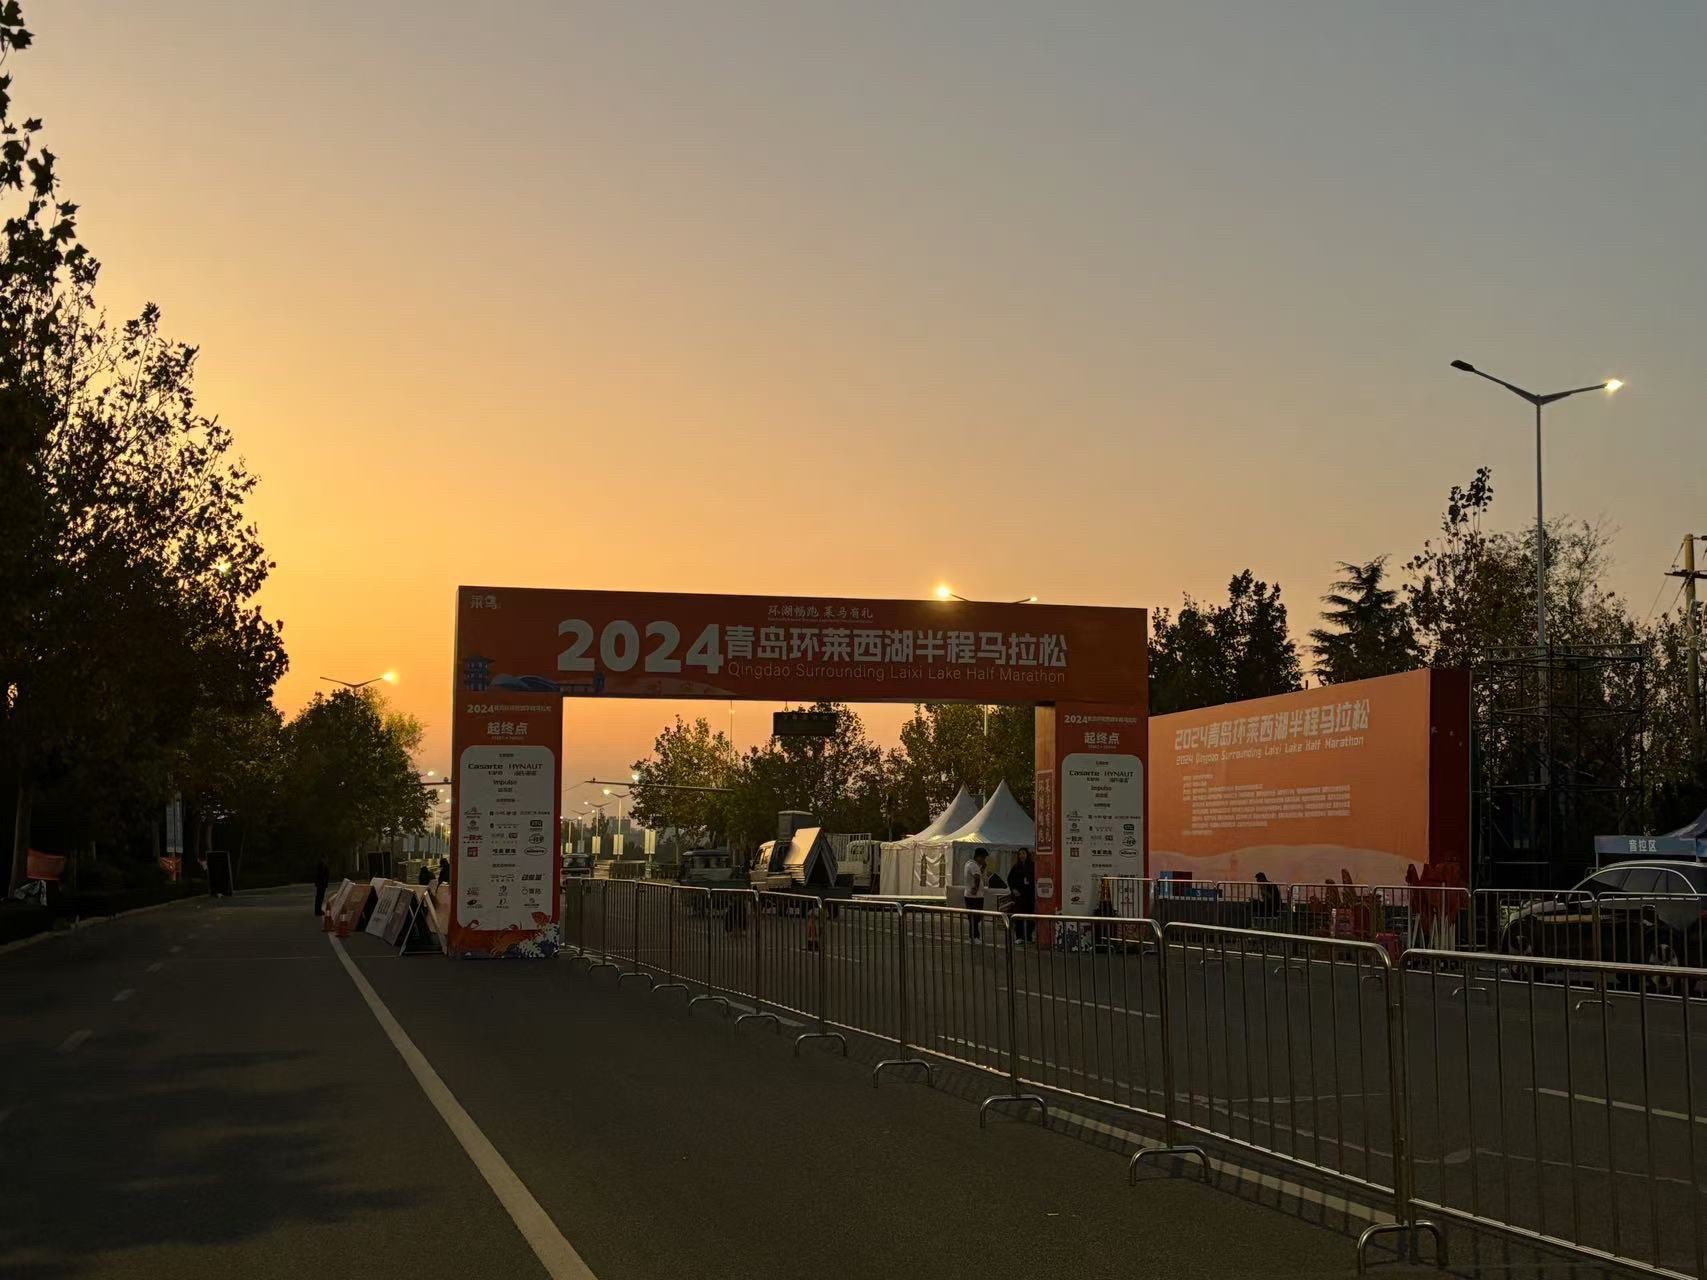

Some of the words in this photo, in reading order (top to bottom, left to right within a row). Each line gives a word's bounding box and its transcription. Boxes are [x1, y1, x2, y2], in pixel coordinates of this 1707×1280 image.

[768, 605, 819, 617] 环湖畅跑
[824, 606, 873, 619] 莱马有礼
[557, 618, 1068, 674] 2024青岛环莱西湖半程马拉松
[728, 661, 791, 680] Qingdao
[795, 662, 885, 681] Surrounding
[890, 665, 922, 680] Laixi
[928, 666, 961, 680] Lake
[966, 666, 994, 681] Half
[1000, 667, 1066, 684] Marathon
[487, 722, 528, 735] 起终点
[1174, 698, 1370, 750] 2024青岛环莱西湖半程马拉松
[1084, 732, 1120, 745] 起终点
[1176, 755, 1193, 766] 2024
[1221, 747, 1262, 761] Surrounding
[1265, 745, 1282, 756] Laixi
[1285, 743, 1303, 754] Lake
[1305, 740, 1321, 750] Half
[1325, 736, 1364, 749] Marathon
